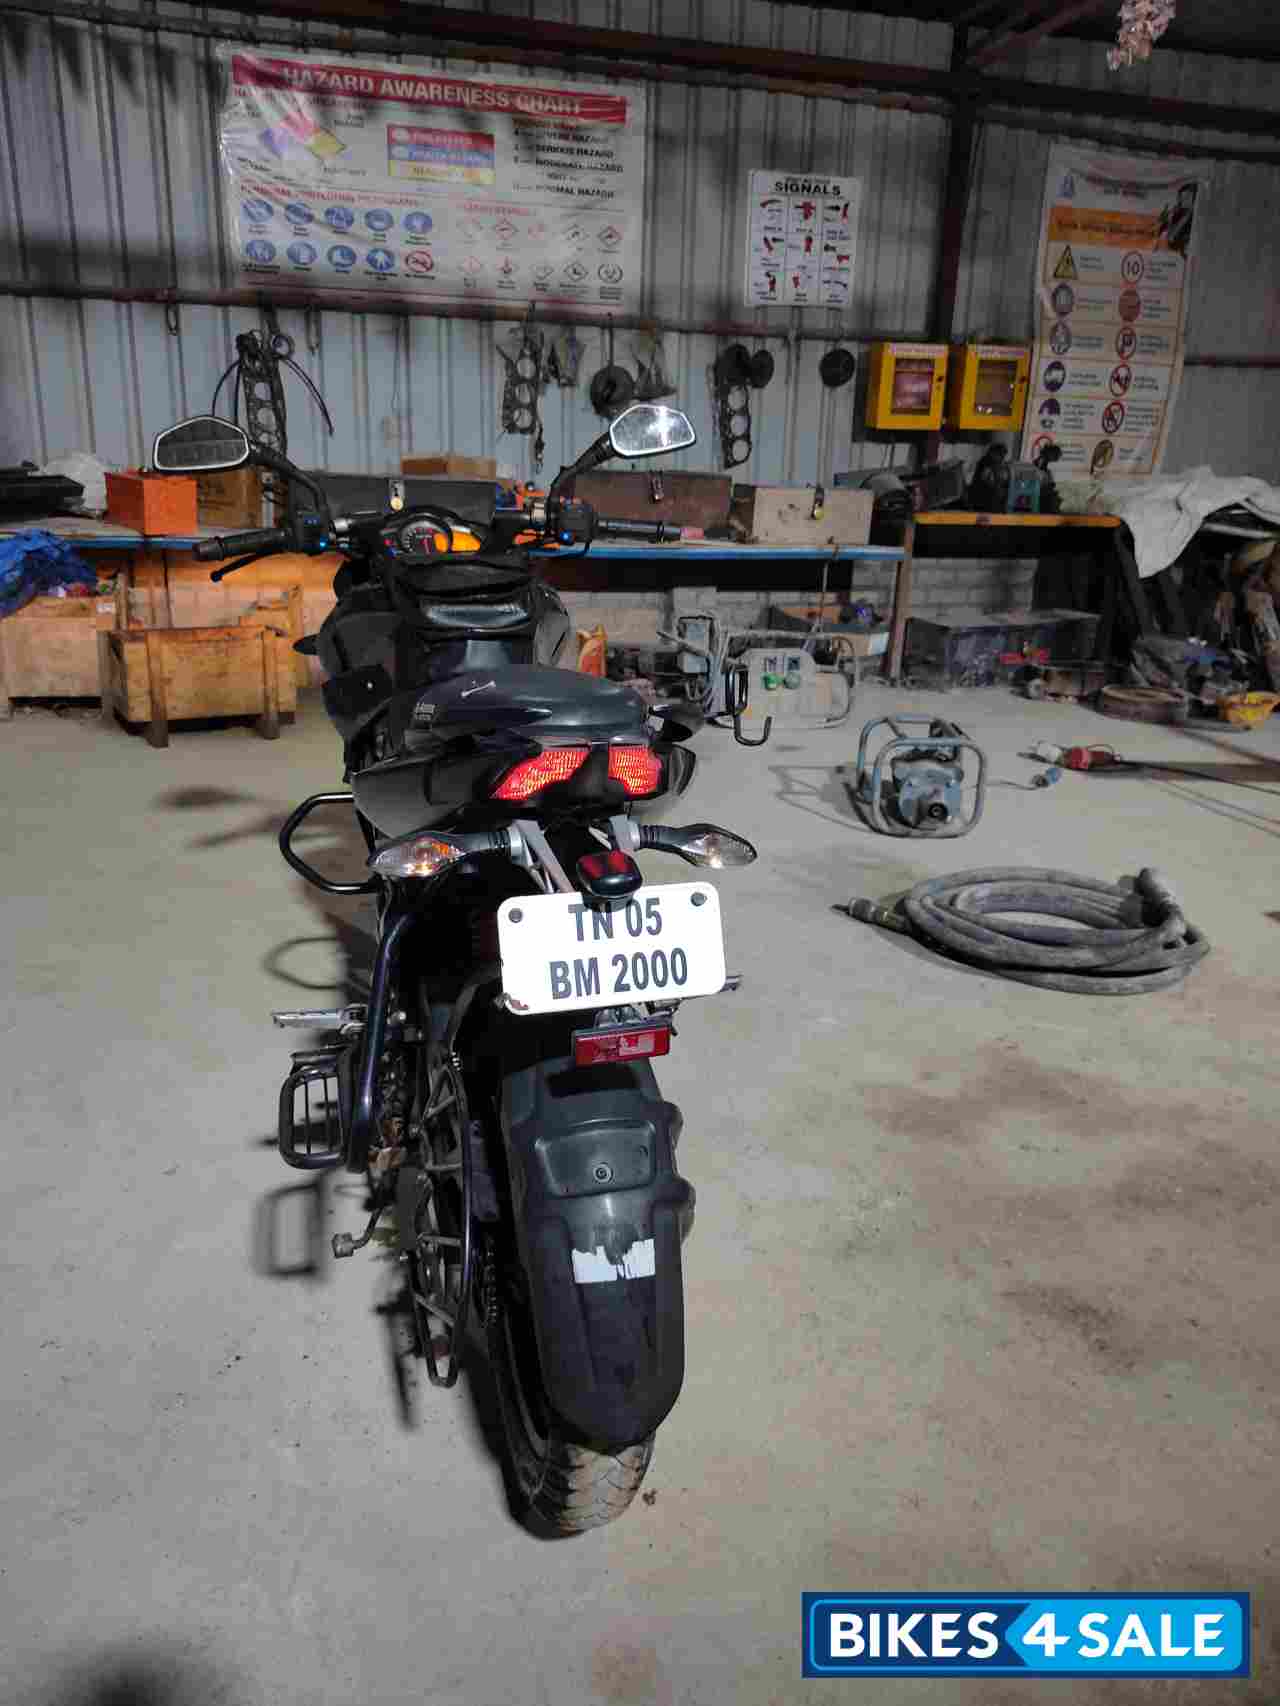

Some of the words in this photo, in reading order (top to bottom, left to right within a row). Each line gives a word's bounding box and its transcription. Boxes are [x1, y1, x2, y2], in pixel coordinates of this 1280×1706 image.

[284, 67, 374, 92] HAZARD
[381, 78, 509, 107] AWARENESS
[514, 94, 580, 114] CHART
[775, 181, 841, 195] SIGNALS
[1127, 261, 1140, 275] 10
[568, 902, 614, 941] TN
[625, 897, 662, 937] 05
[549, 957, 601, 1000] BM
[611, 947, 688, 993] 2000
